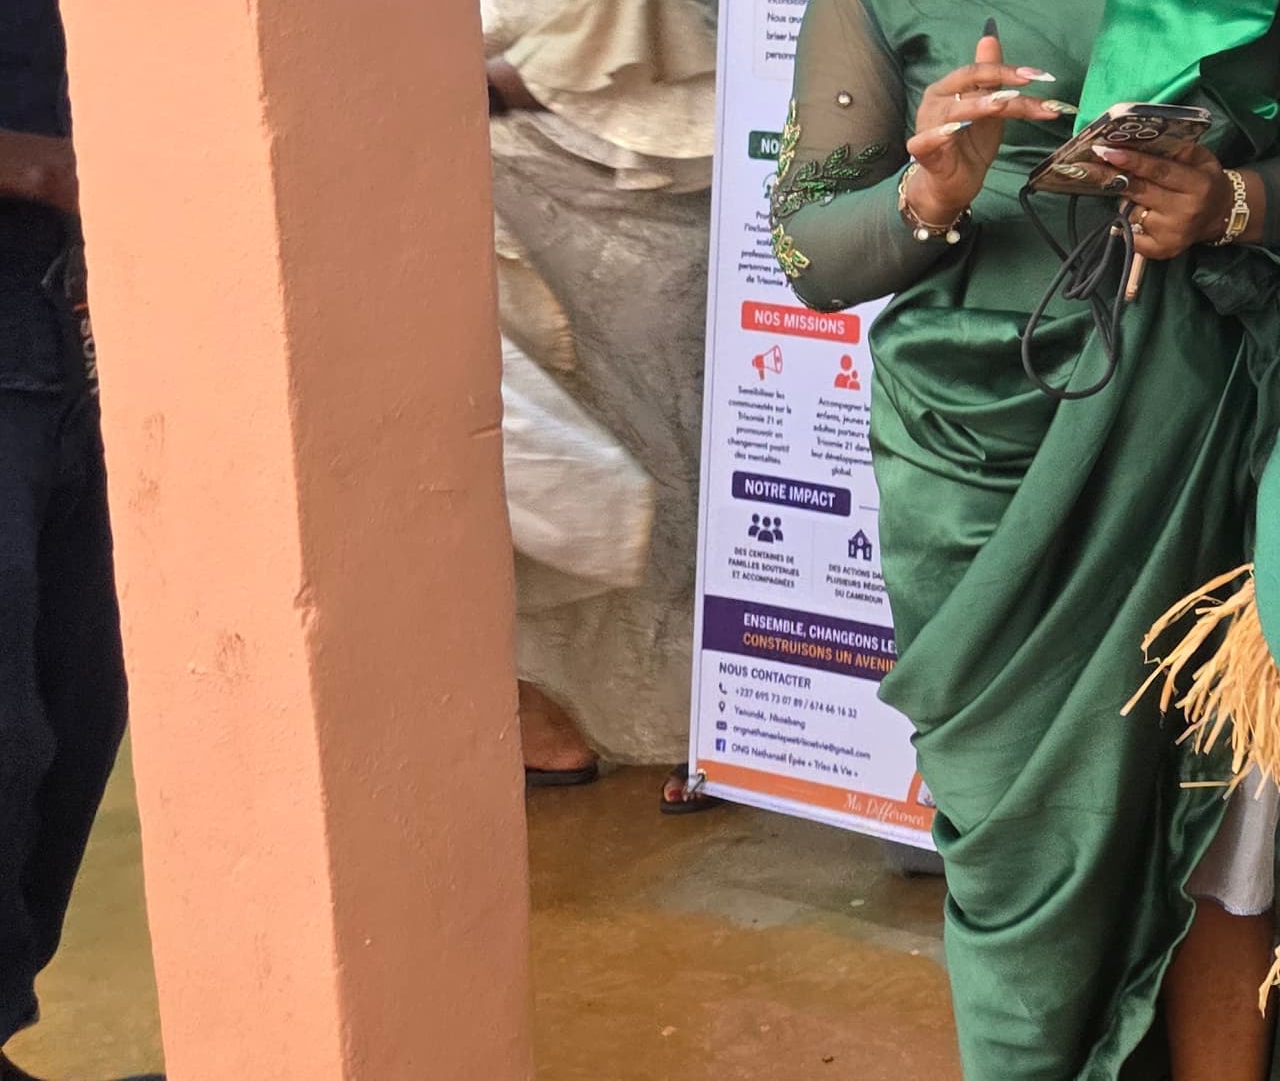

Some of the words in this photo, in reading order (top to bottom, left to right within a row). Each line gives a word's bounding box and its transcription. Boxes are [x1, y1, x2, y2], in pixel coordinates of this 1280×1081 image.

[754, 310, 781, 327] NOS
[784, 314, 845, 336] MISSIONS
[745, 478, 786, 500] NOTRE
[789, 486, 836, 508] IMPACT
[743, 613, 807, 638] ENSEMBLE,
[809, 624, 879, 651] CHANGEONS
[881, 638, 898, 654] LE
[743, 632, 832, 661] CONSTRUISONS
[835, 650, 851, 664] UN
[719, 662, 748, 678] NOUS
[751, 668, 811, 689] CONTACTER
[731, 742, 750, 756] ONG
